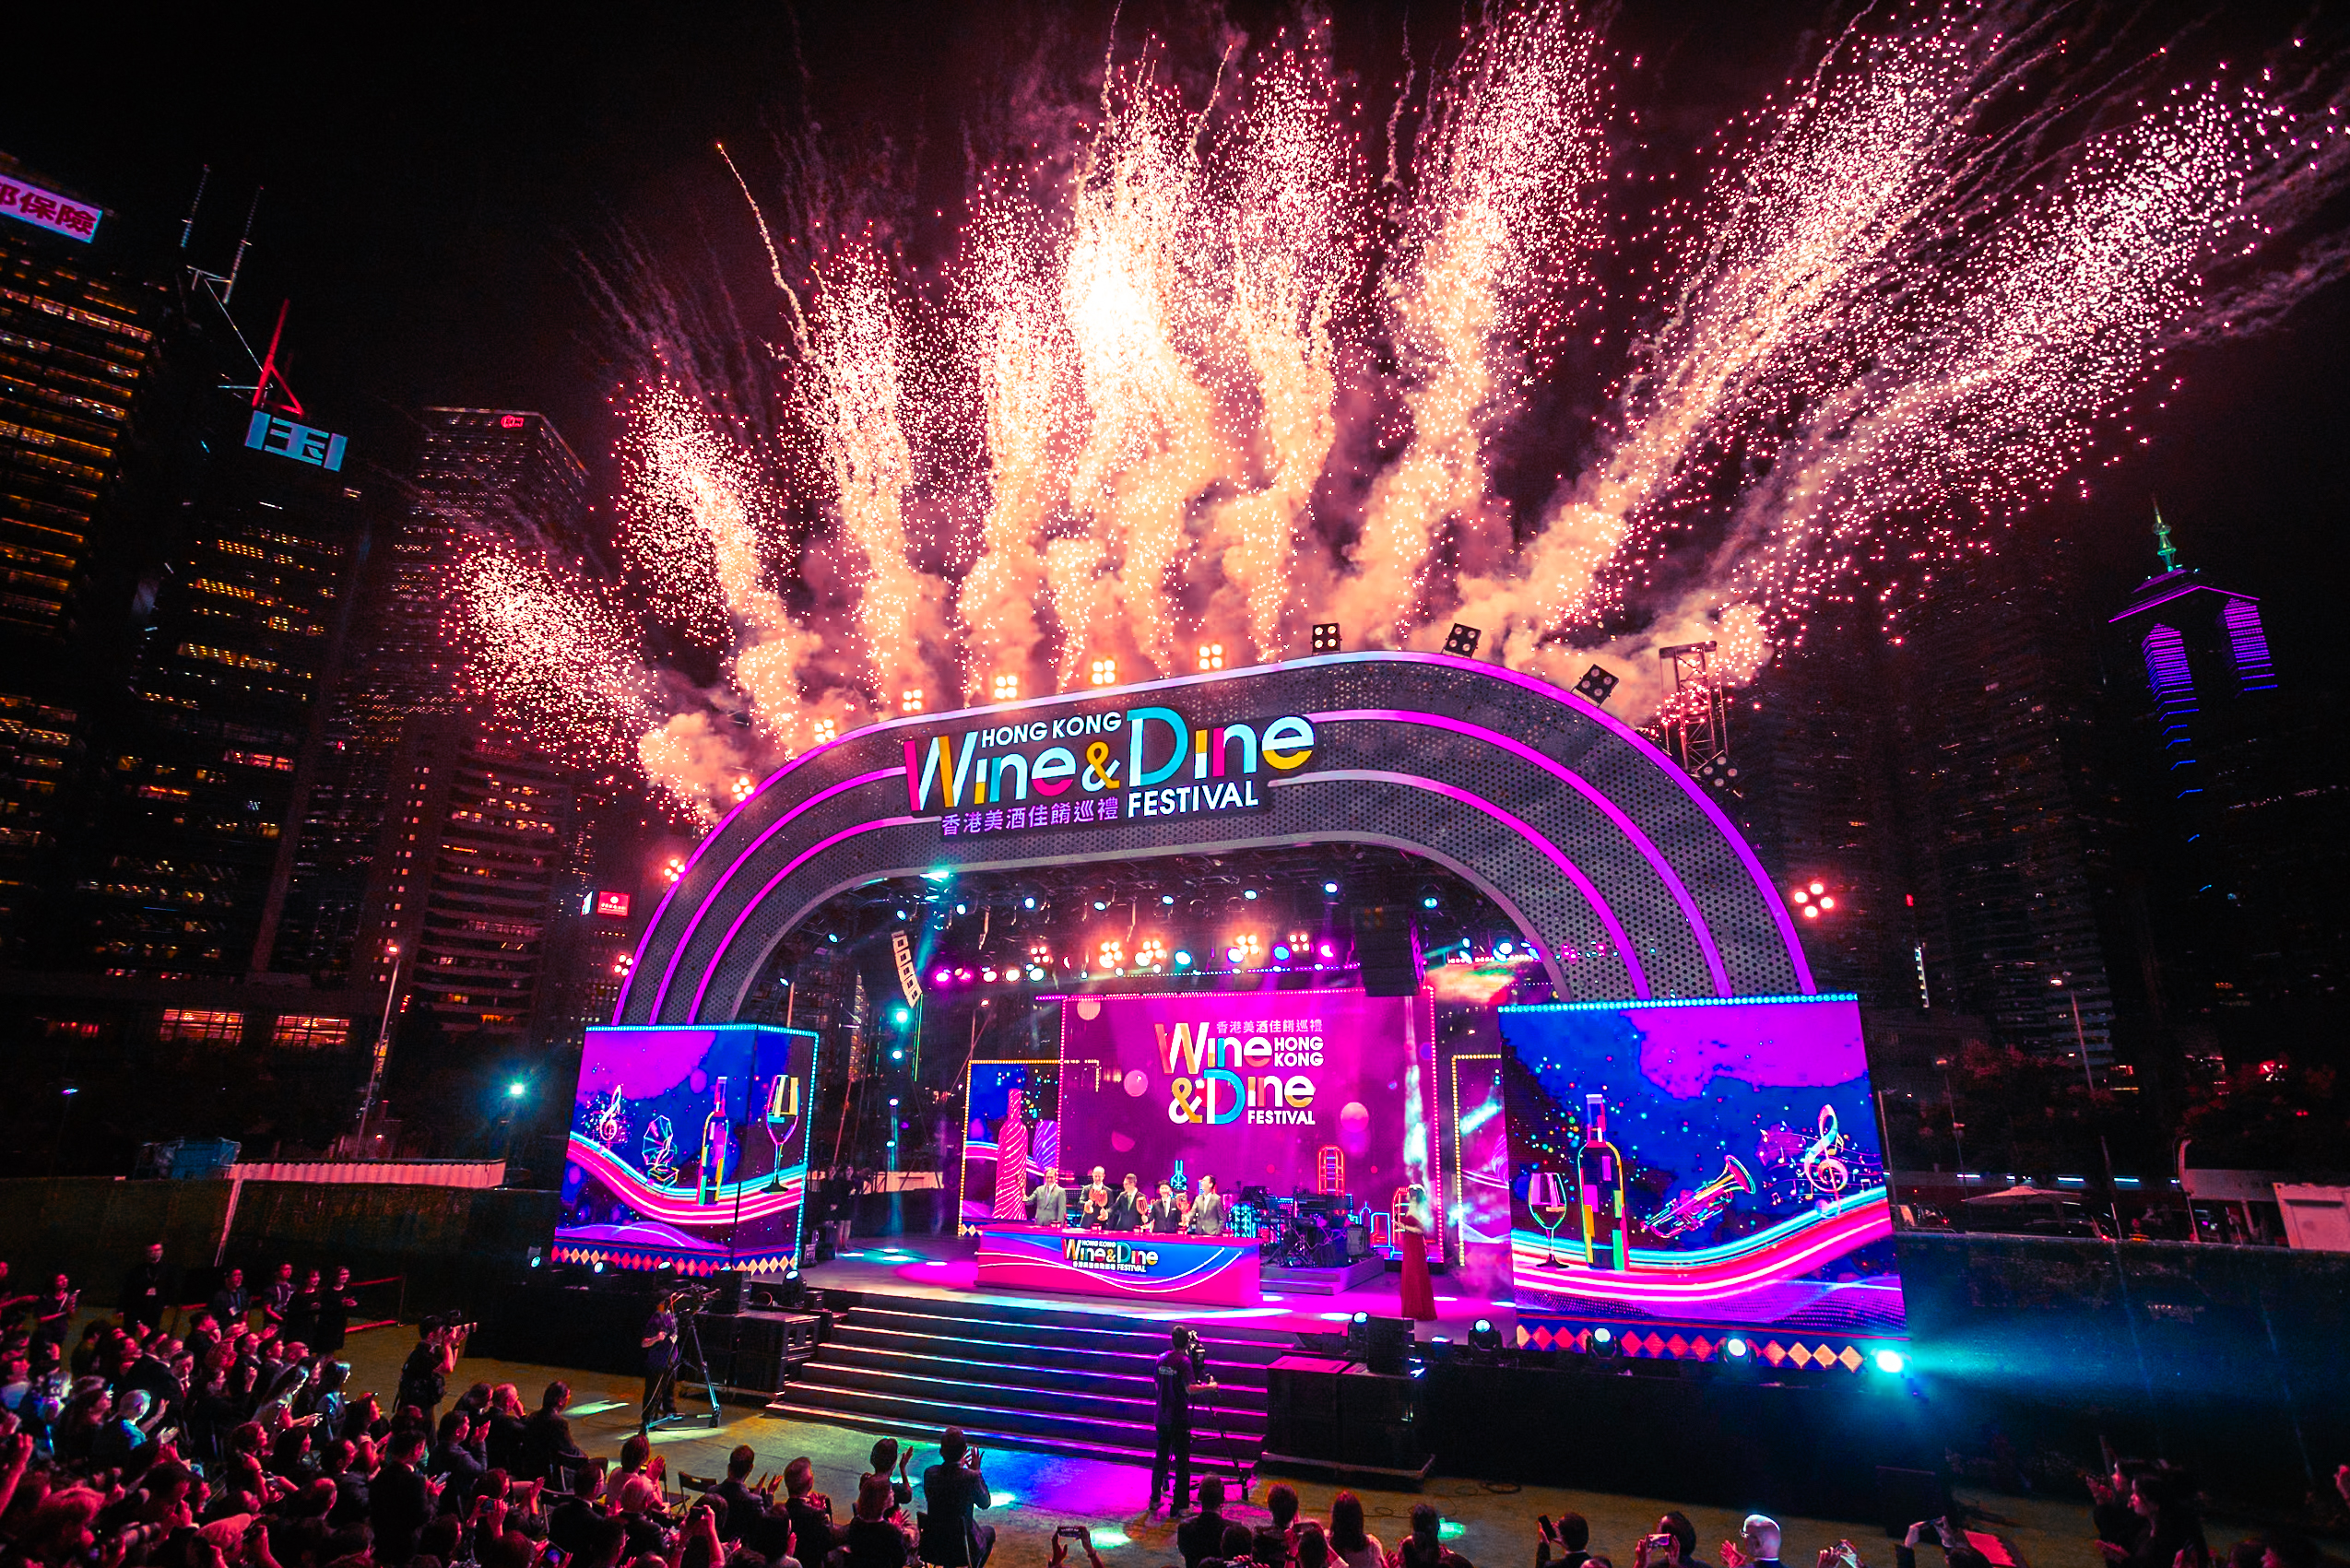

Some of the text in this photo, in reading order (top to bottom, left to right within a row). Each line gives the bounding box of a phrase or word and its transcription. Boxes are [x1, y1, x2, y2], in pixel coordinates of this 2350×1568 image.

[981, 711, 1122, 749] HONG KONG
[903, 706, 1316, 811] Wine & Dine
[941, 796, 1119, 836] 香港美酒佳餚巡禮
[1128, 781, 1259, 819] FESTIVAL
[1216, 1019, 1324, 1034] 香港美酒佳餚巡禮
[1154, 1021, 1272, 1075] Wine
[1274, 1036, 1324, 1051] HONG
[1274, 1052, 1324, 1067] KONG
[1203, 1068, 1316, 1125] Dine
[1247, 1110, 1316, 1125] FESTIVAL
[1061, 1238, 1106, 1262] Wine
[1116, 1241, 1159, 1266] Dine
[1116, 1263, 1147, 1273] FESTIVAL
